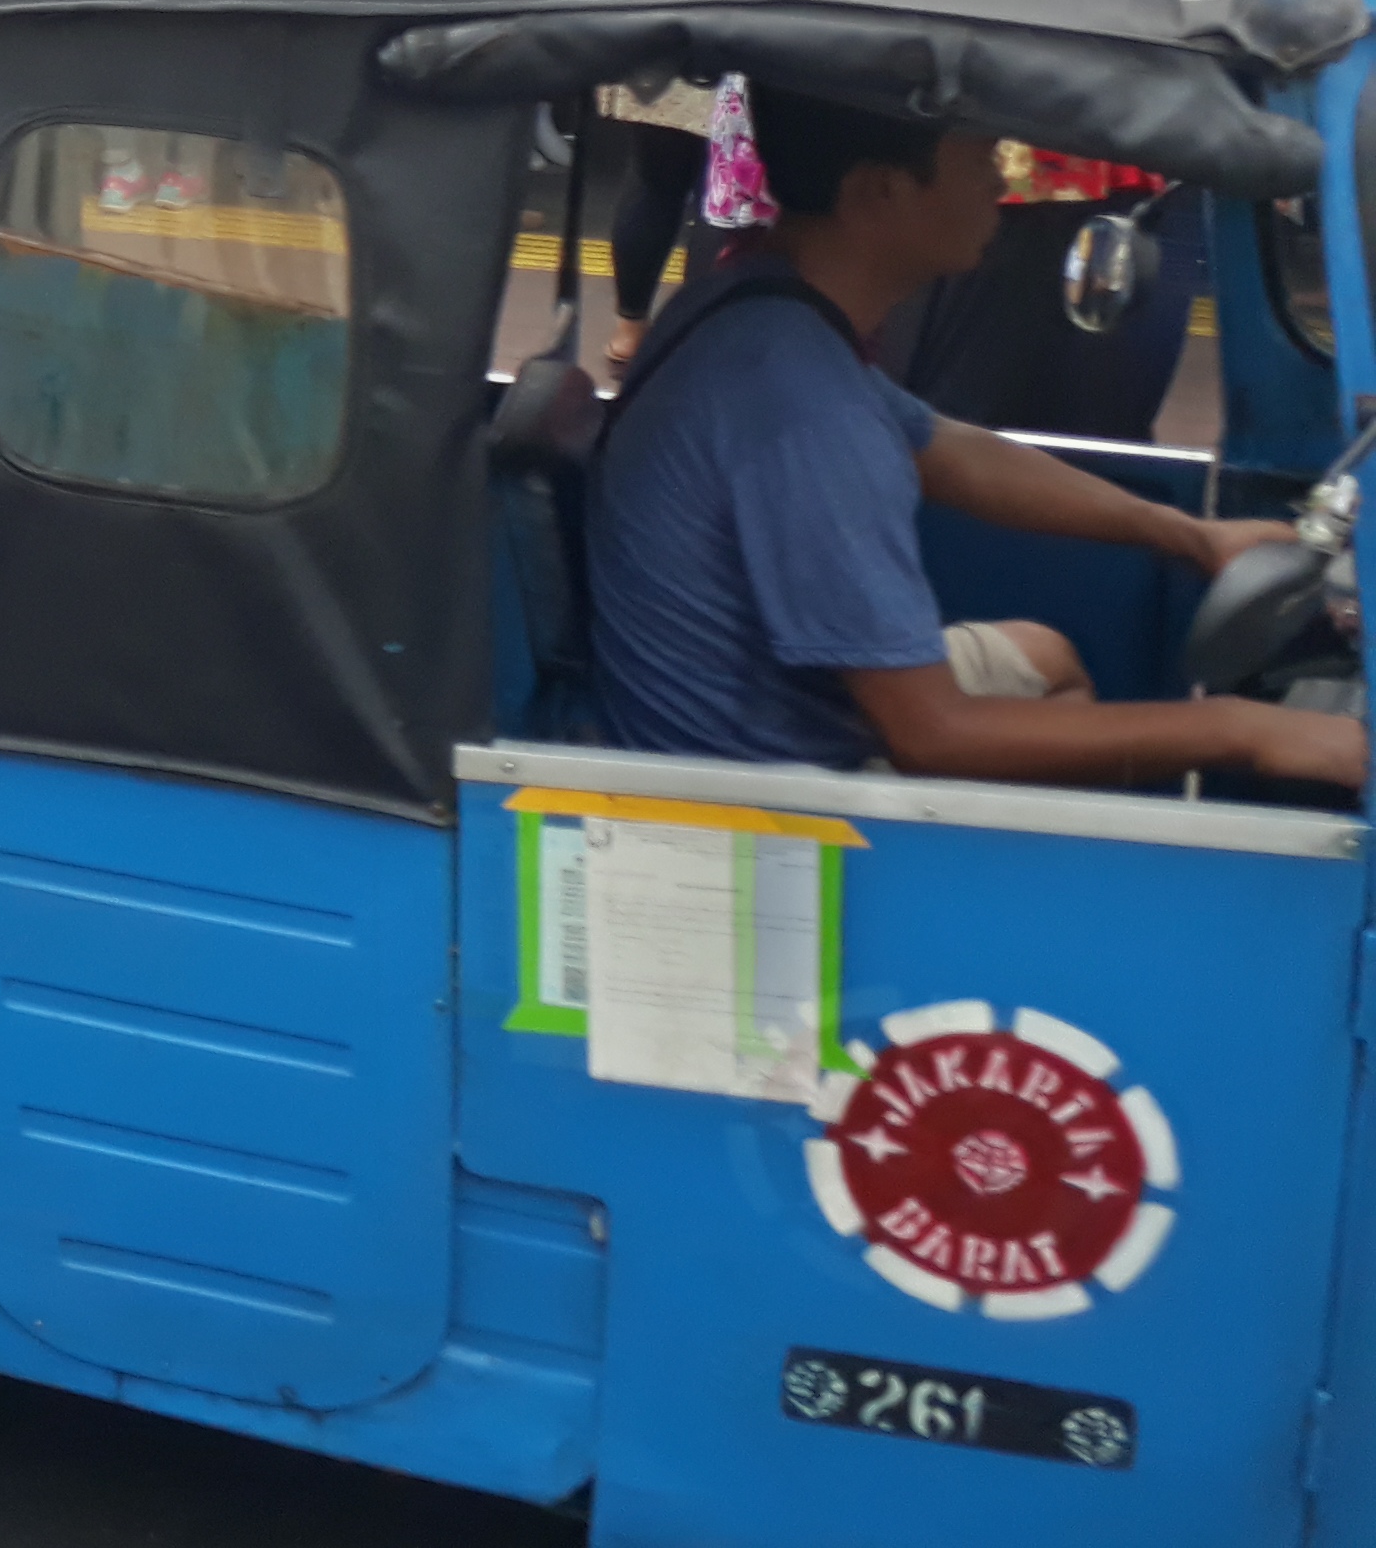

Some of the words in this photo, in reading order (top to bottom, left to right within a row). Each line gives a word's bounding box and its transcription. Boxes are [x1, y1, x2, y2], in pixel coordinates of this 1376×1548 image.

[873, 1045, 1116, 1158] JAKARTA
[877, 1197, 1067, 1283] BARAT
[857, 1368, 986, 1439] 261
